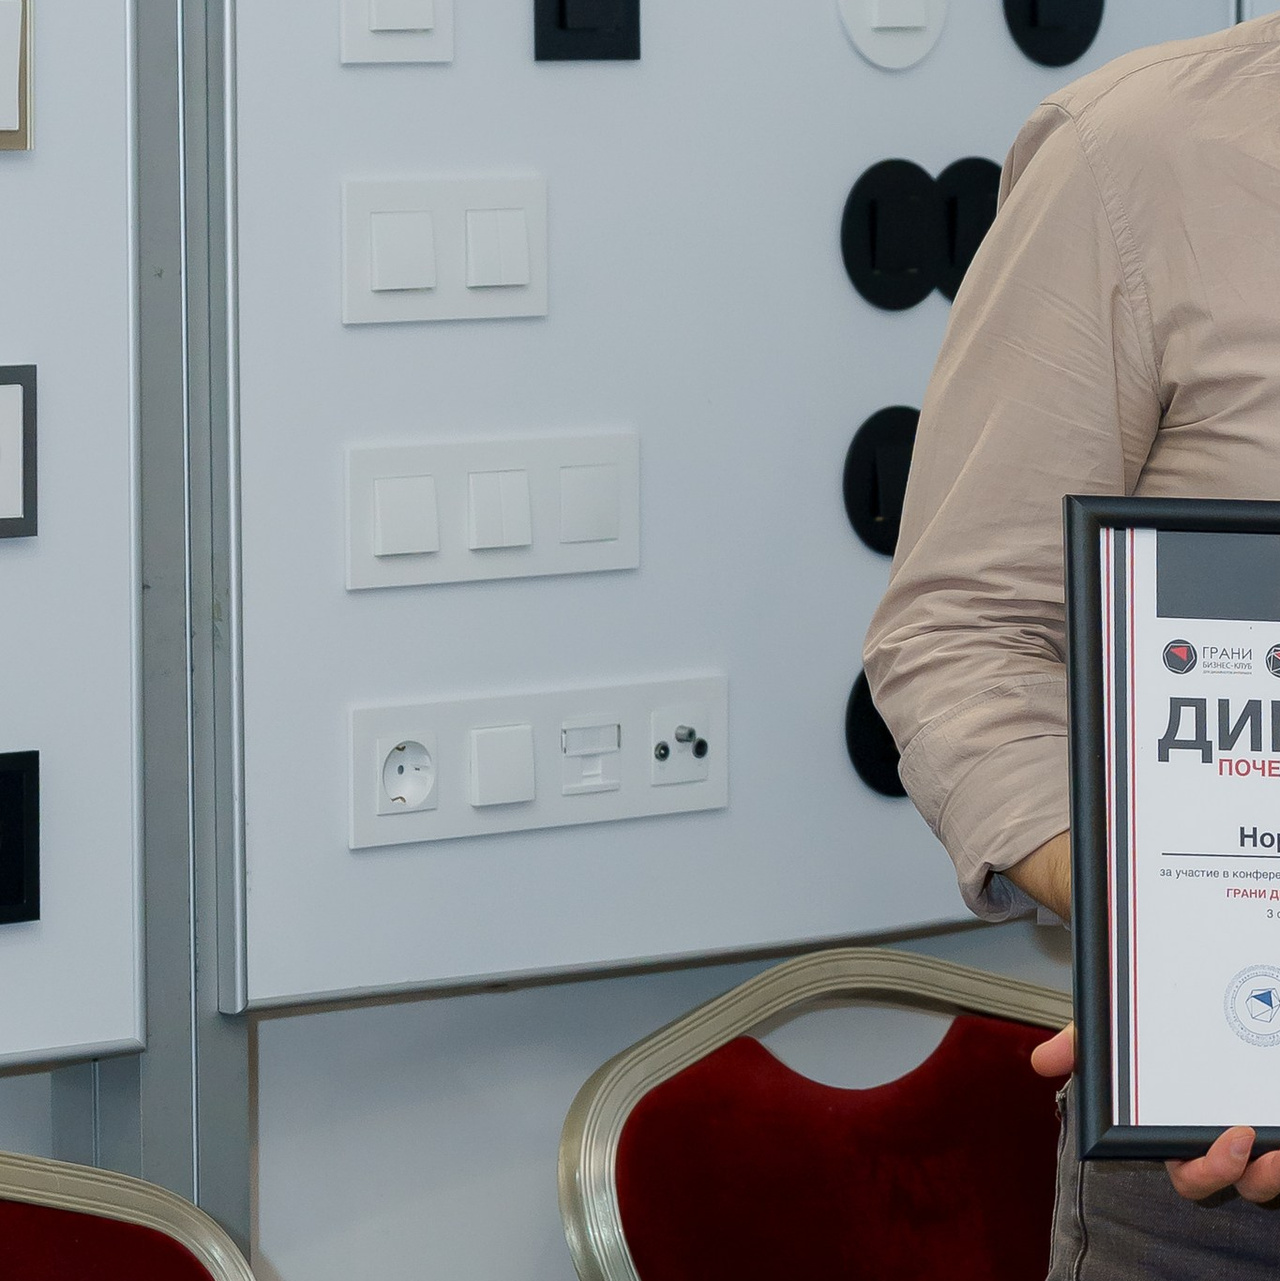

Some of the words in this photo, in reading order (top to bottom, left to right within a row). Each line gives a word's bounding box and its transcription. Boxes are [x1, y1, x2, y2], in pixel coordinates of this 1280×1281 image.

[1202, 647, 1253, 662] ГРАНИ
[1202, 661, 1253, 670] БИЗНЕС-КЛУБ
[1159, 868, 1172, 877] за
[1175, 869, 1220, 879] участие
[1222, 870, 1230, 878] в
[1226, 888, 1267, 899] ГРАНИ
[1266, 909, 1274, 919] 3
